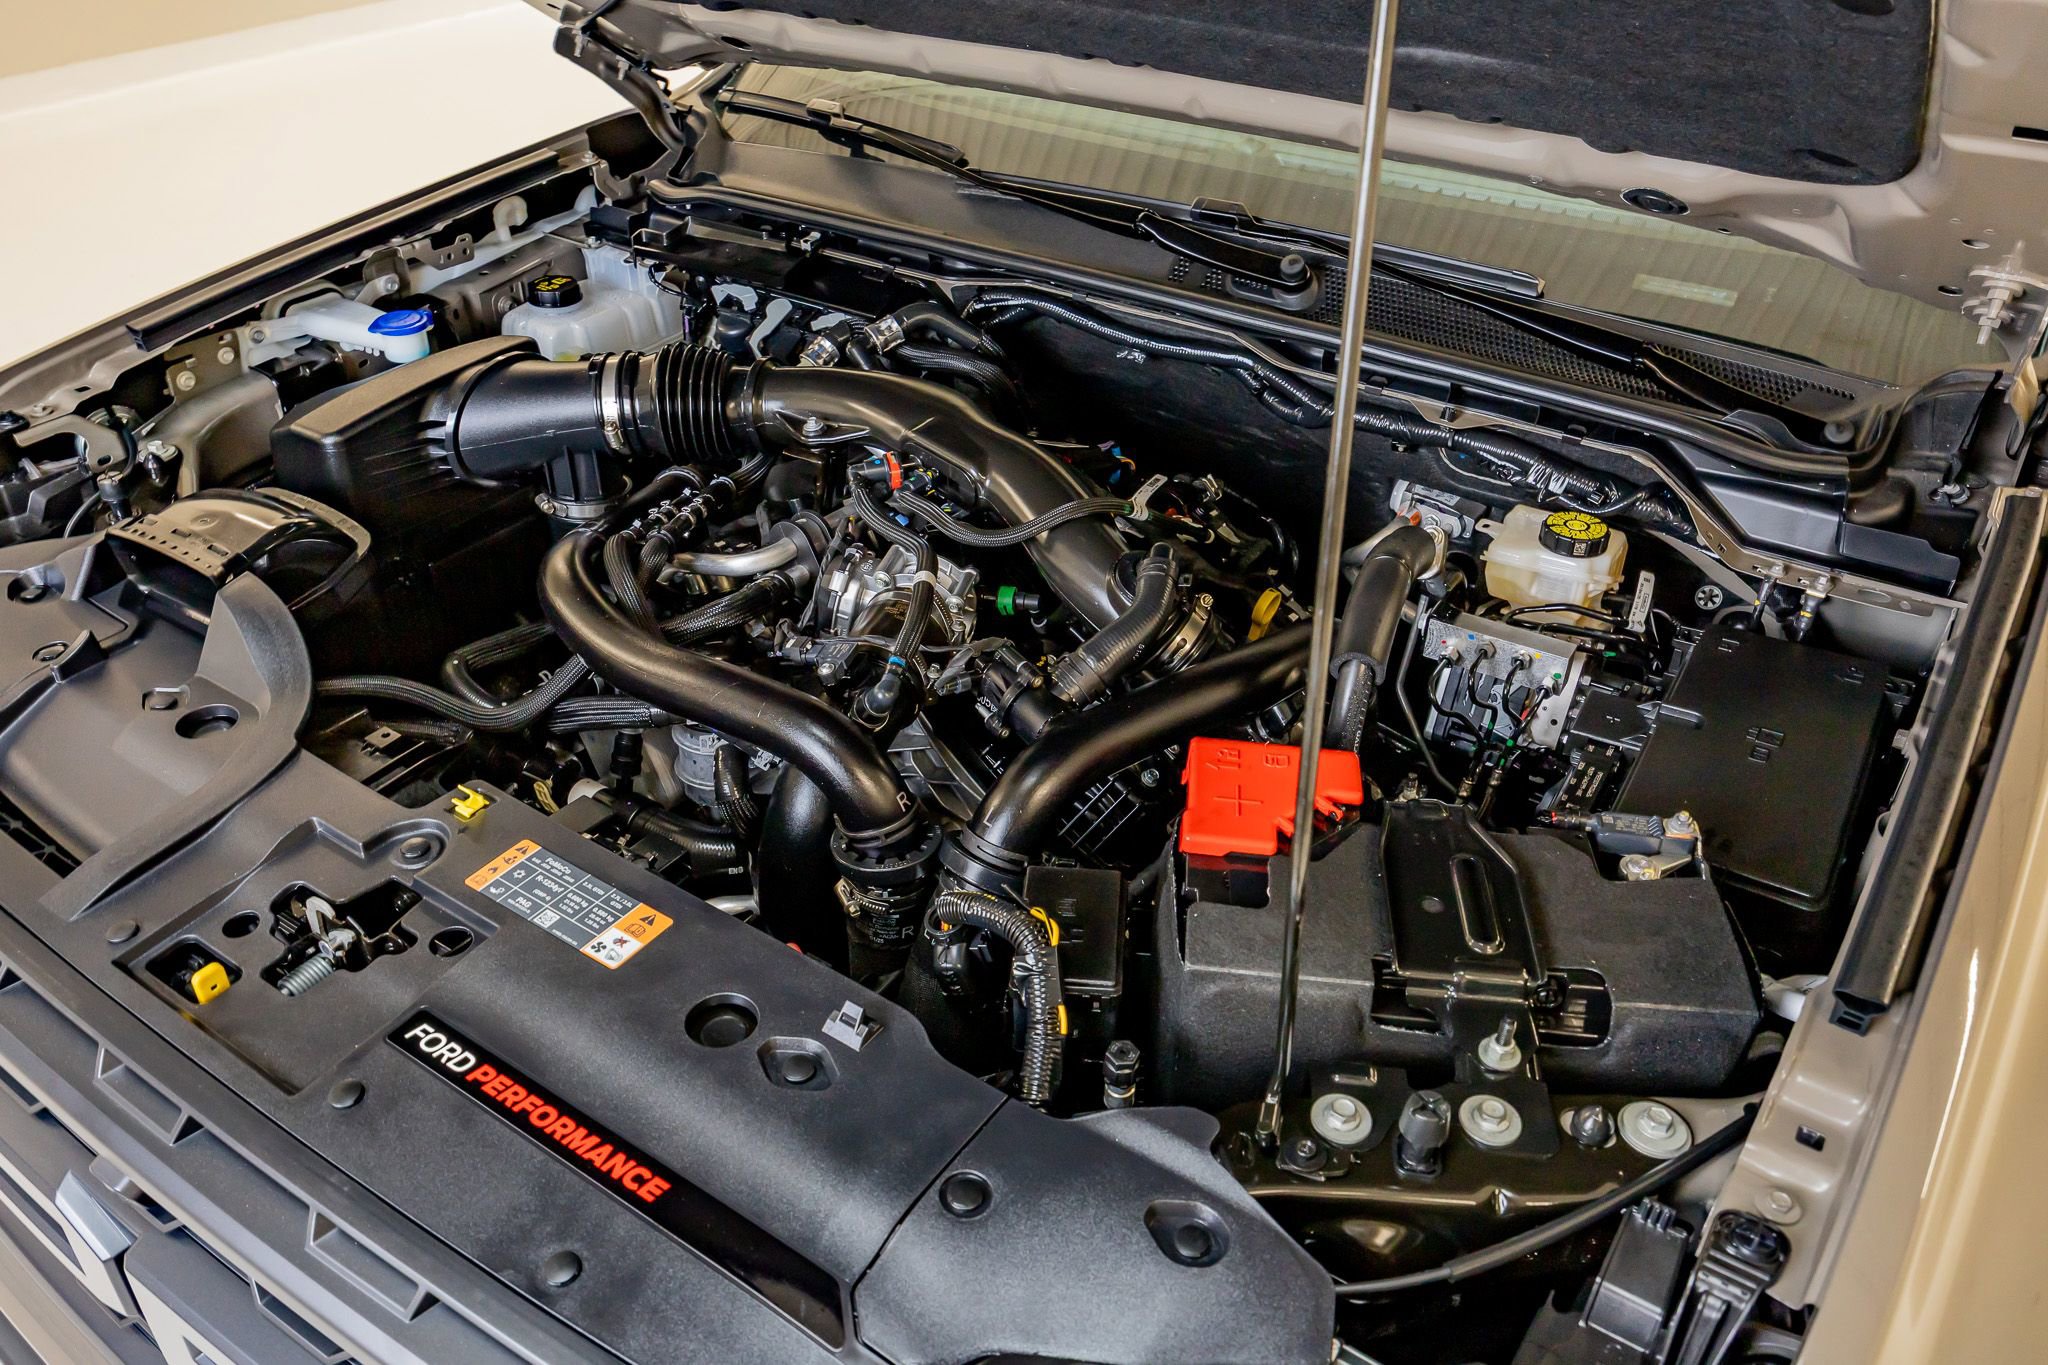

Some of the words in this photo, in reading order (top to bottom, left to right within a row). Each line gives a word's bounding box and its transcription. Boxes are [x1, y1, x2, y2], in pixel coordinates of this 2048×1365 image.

[896, 791, 911, 812] R
[983, 807, 994, 827] L
[545, 858, 571, 874] FoMoCo
[535, 875, 564, 892] R-1234yf
[516, 896, 532, 907] PAG
[901, 925, 915, 939] R
[404, 1023, 476, 1073] FORD
[465, 1063, 672, 1204] PERFORMANCE
